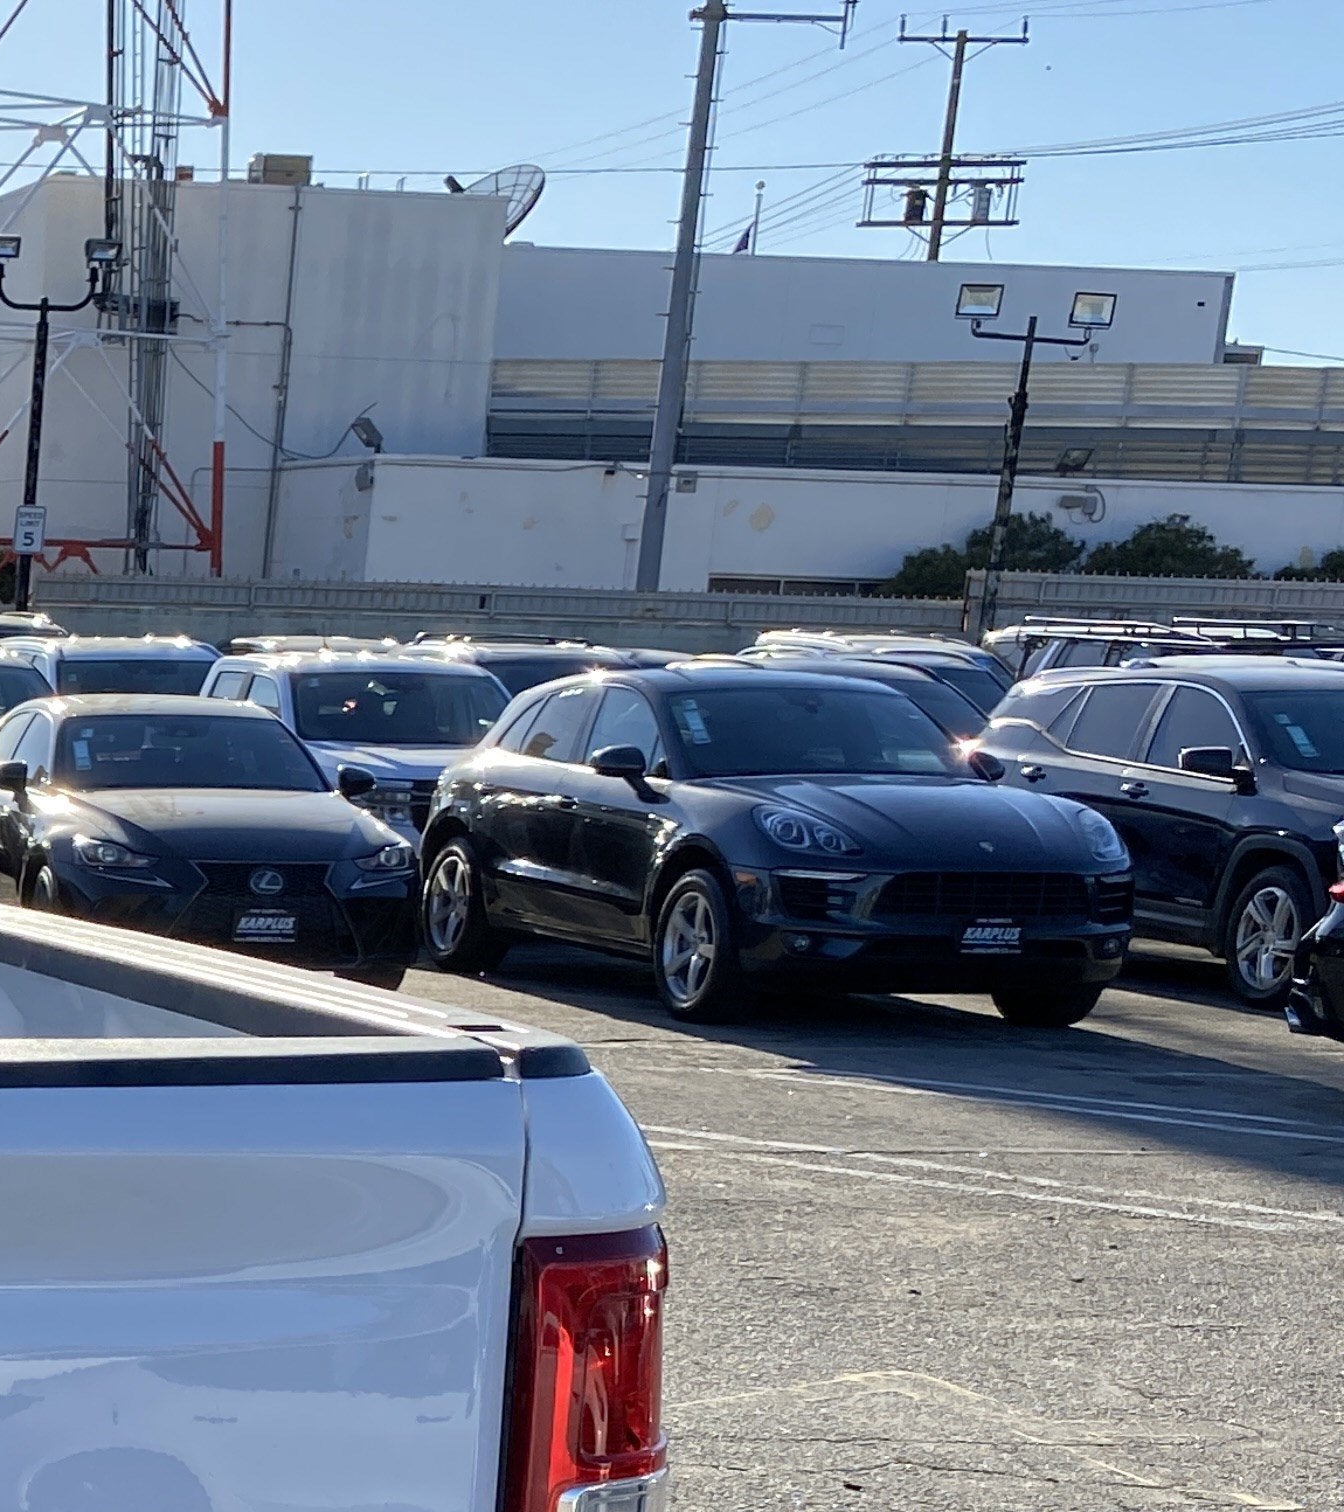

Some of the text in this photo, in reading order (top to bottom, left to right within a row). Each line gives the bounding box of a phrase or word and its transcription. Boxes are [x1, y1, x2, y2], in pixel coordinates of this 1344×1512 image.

[22, 531, 35, 547] 5
[237, 916, 296, 930] KARPLUS
[962, 927, 1022, 940] KARPLUS
